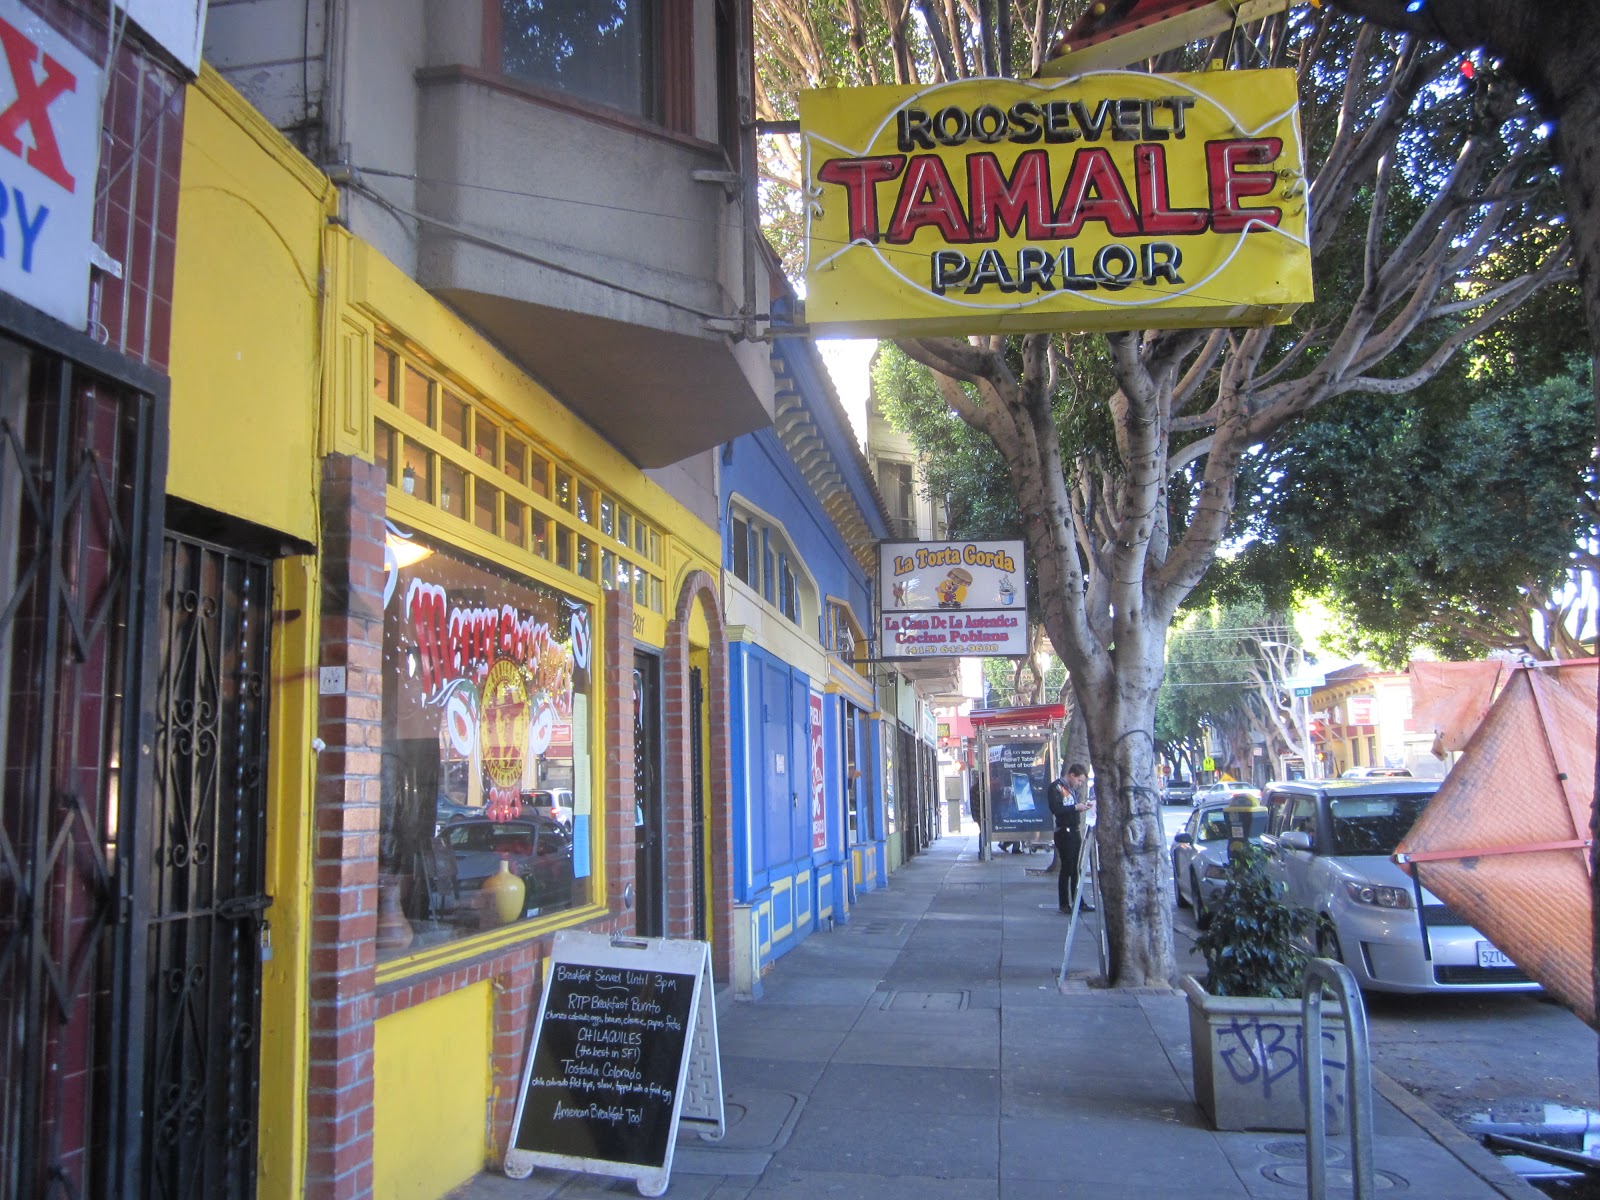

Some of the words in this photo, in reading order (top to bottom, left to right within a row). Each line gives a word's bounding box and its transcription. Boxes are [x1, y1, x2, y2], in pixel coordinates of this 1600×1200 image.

[897, 95, 1195, 151] ROOSEVELT
[818, 138, 1283, 244] TAMALE
[931, 242, 1185, 296] PARLOR
[894, 555, 915, 577] La
[916, 546, 961, 569] Torta
[963, 544, 1016, 573] Gorda
[885, 616, 899, 630] La
[901, 616, 930, 630] Casa
[931, 615, 947, 629] De
[949, 615, 963, 629] La
[965, 614, 1018, 628] Autentica
[895, 631, 947, 645] Cocina
[949, 630, 1009, 643] Poblana
[905, 645, 937, 654] (415)
[940, 643, 999, 653] 642-9600
[557, 966, 591, 984] Breakfast
[595, 968, 621, 984] Served
[626, 971, 649, 985] Until
[568, 993, 591, 1010] RTP
[591, 995, 629, 1014] Breakfast
[630, 996, 661, 1014] Burrito
[578, 1027, 642, 1045] CHILAQUILES
[575, 1043, 592, 1058] (the
[592, 1046, 610, 1058] best
[611, 1048, 619, 1058] in
[560, 1059, 599, 1076] Tostada
[602, 1061, 642, 1079] Colorado
[553, 1100, 589, 1120] American
[589, 1102, 624, 1127] Breakfast
[625, 1107, 643, 1128] Too!
